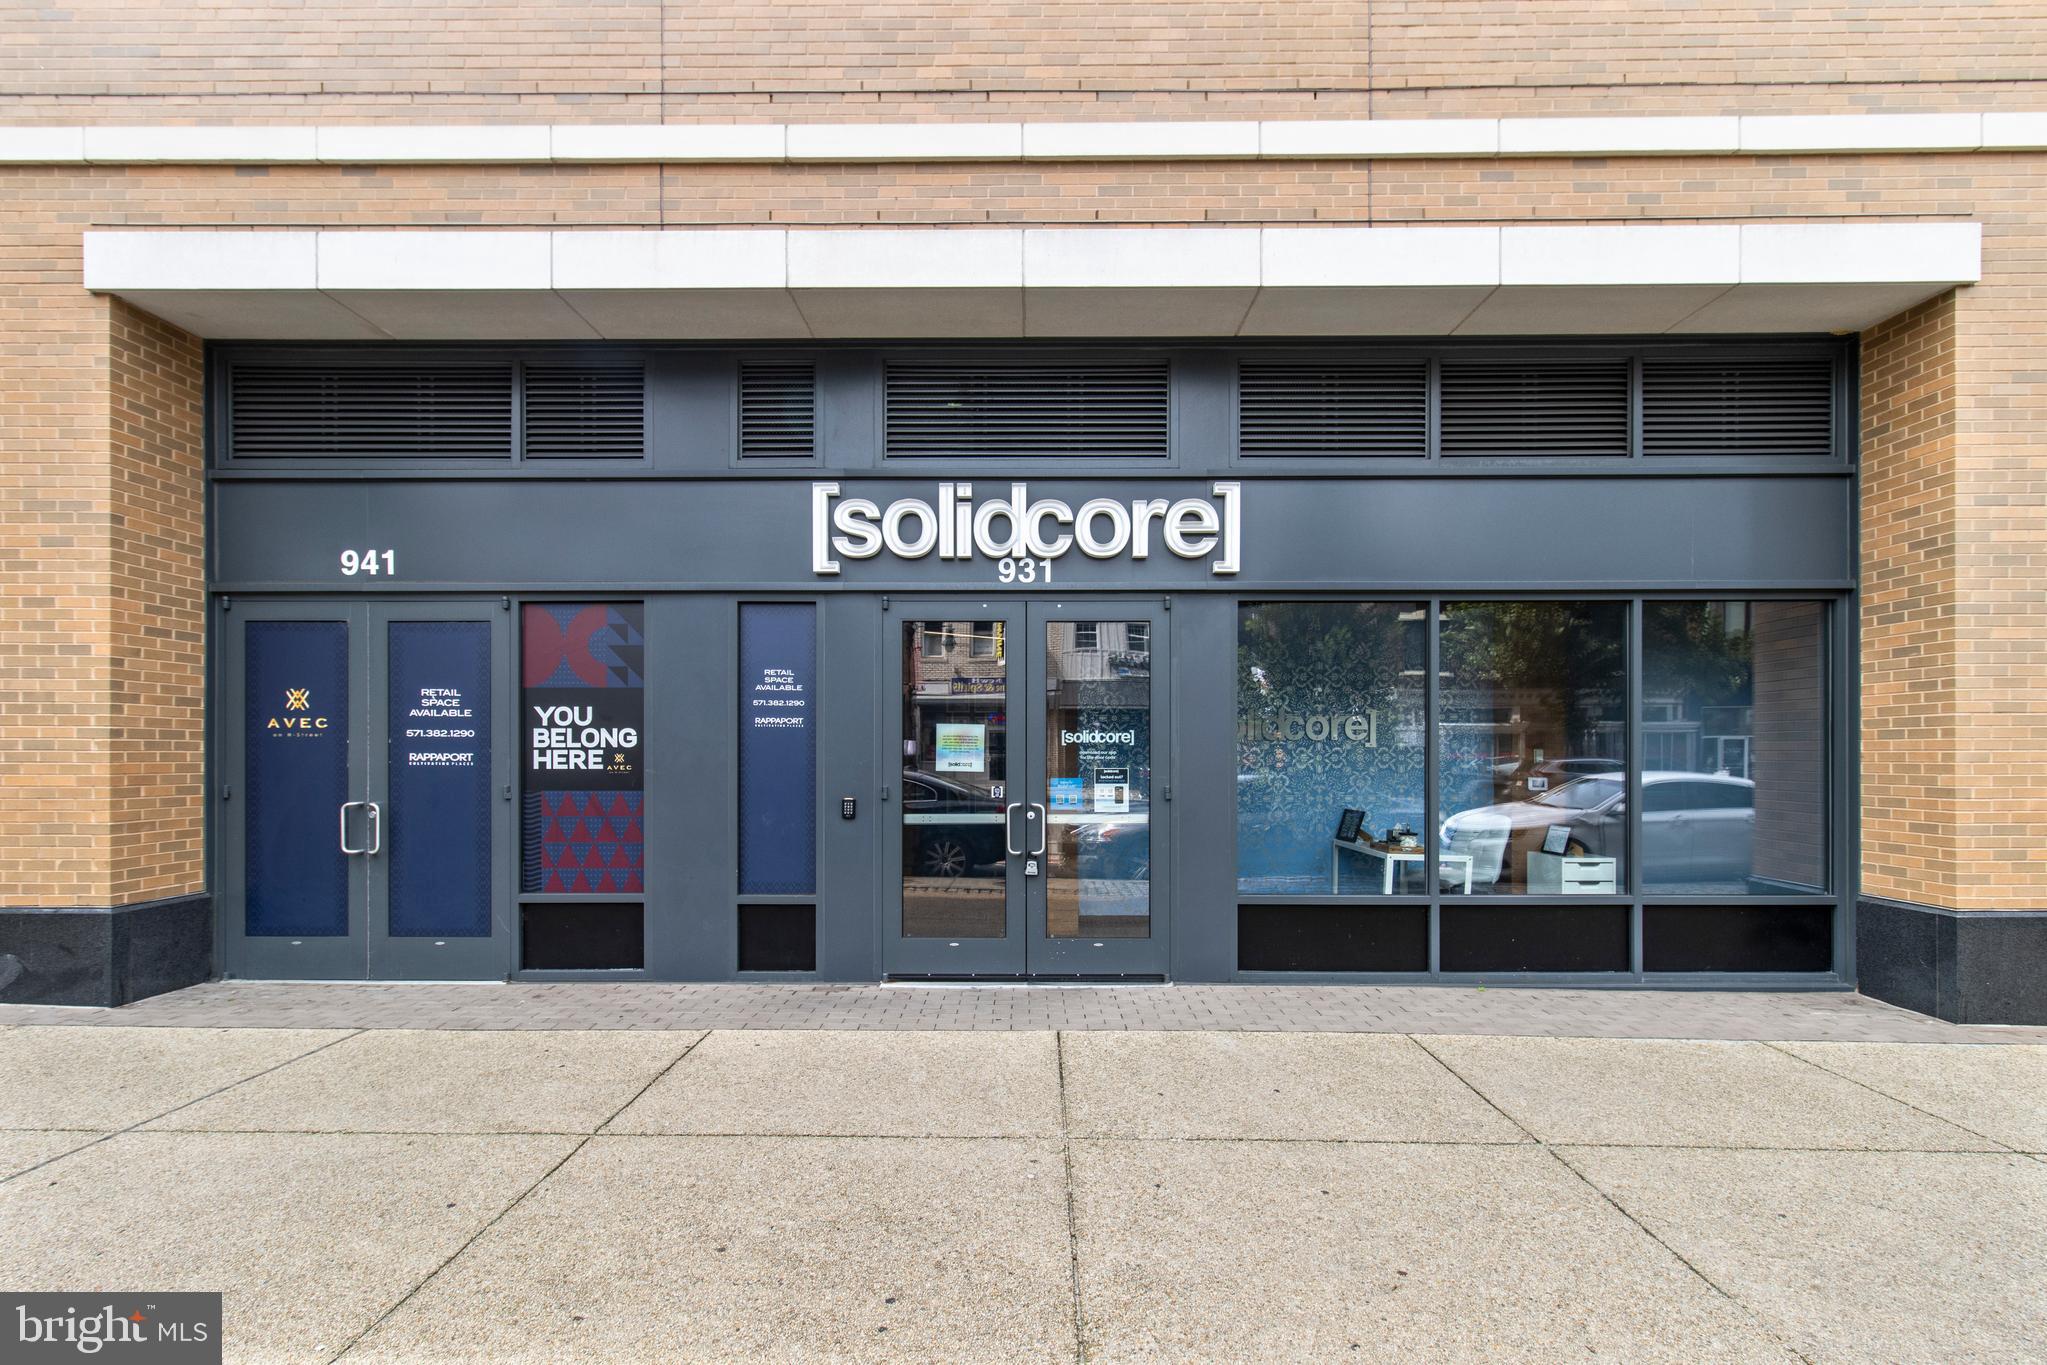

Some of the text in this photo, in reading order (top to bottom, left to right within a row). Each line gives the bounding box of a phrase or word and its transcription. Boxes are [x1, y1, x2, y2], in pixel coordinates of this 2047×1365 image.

[812, 481, 1241, 575] [solidcore]
[340, 549, 395, 576] 941
[998, 558, 1051, 583] 931
[420, 688, 461, 696] RETAIL
[421, 699, 460, 707] SPACE
[753, 699, 805, 707] 571.382.1290
[409, 709, 472, 717] AVAILABLE
[533, 706, 593, 726] YOU
[267, 717, 328, 729] AVEC
[406, 729, 475, 737] 571.382.1290
[533, 728, 638, 748] BELONG
[1061, 729, 1135, 746] [solidcore]
[409, 752, 474, 761] RAPPAPORT
[533, 749, 604, 770] HERE
